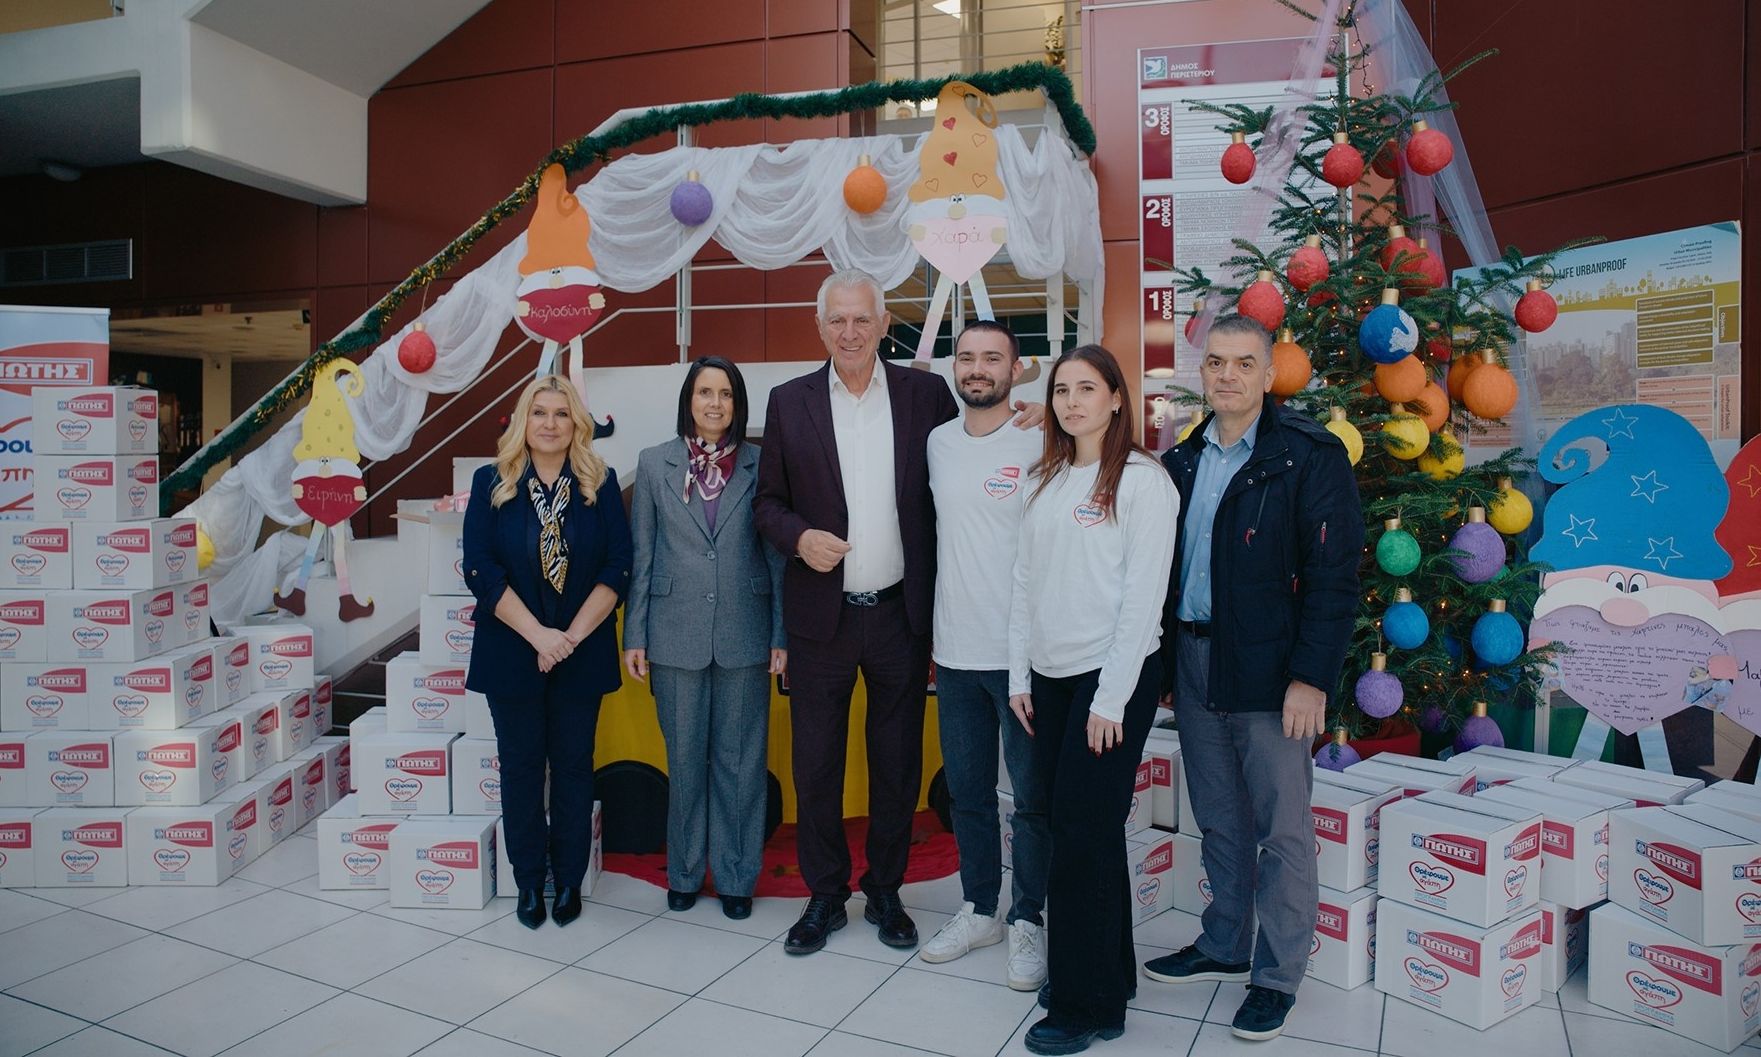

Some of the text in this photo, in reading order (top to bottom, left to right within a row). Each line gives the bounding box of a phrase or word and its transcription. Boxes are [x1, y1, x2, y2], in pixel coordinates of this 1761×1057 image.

[1171, 63, 1198, 71] ΔΗΜΟΣ
[1171, 69, 1215, 78] ΠΕΡΙΣΤΕΡΙΟΥ
[1145, 108, 1159, 127] 3
[1161, 107, 1169, 135] ΟΡΟΦΟΣ
[1146, 200, 1160, 218] 2
[1162, 198, 1171, 227] ΟΡΟΦΟΣ
[1576, 258, 1627, 277] URBANPROOF
[1150, 291, 1158, 310] 1
[1163, 291, 1172, 320] ΟΡΟΦΟΣ
[68, 401, 105, 409] ΓΙΩΤΗΣ
[68, 470, 105, 478] ΓΙΩΤΗΣ
[308, 485, 354, 512] Ειρήνη
[22, 537, 61, 545] ΓΙΩΤΗΣ
[107, 537, 142, 545] ΓΙΩΤΗΣ
[0, 608, 36, 617] ΙΩΤΗΣ
[83, 608, 122, 617] ΓΙΩΤΗΣ
[272, 643, 304, 651] ΓΙΩΤΗΣ
[37, 677, 77, 686] ΓΙΩΤΗΣ
[124, 677, 162, 686] ΓΙΩΤΗΣ
[60, 751, 100, 760] ΓΙΩΤΗΣ
[148, 751, 186, 760] ΓΙΩΤΗΣ
[397, 759, 437, 770] ΓΙΩΤΗΣ
[1312, 816, 1339, 830] ΤΗΣ
[74, 831, 113, 840] ΓΙΩΤΗΣ
[166, 830, 205, 839] ΓΙΩΤΗΣ
[1425, 839, 1473, 860] ΓΙΩΤΗΣ
[1510, 838, 1535, 855] ΓΙΩΤΗΣ
[428, 849, 471, 860] ΓΙΩΤΗΣ
[1646, 848, 1689, 872] ΓΙΩΤΗΣ
[1142, 855, 1167, 871] ΓΙΩΤΗΣ
[1420, 936, 1468, 960] ΓΙΩΤΗΣ
[1507, 935, 1535, 954] ΓΙΩΤΗΣ
[1645, 949, 1704, 976] ΓΙΩΤΗΣ
[1633, 976, 1676, 997] Θρέφουμε
